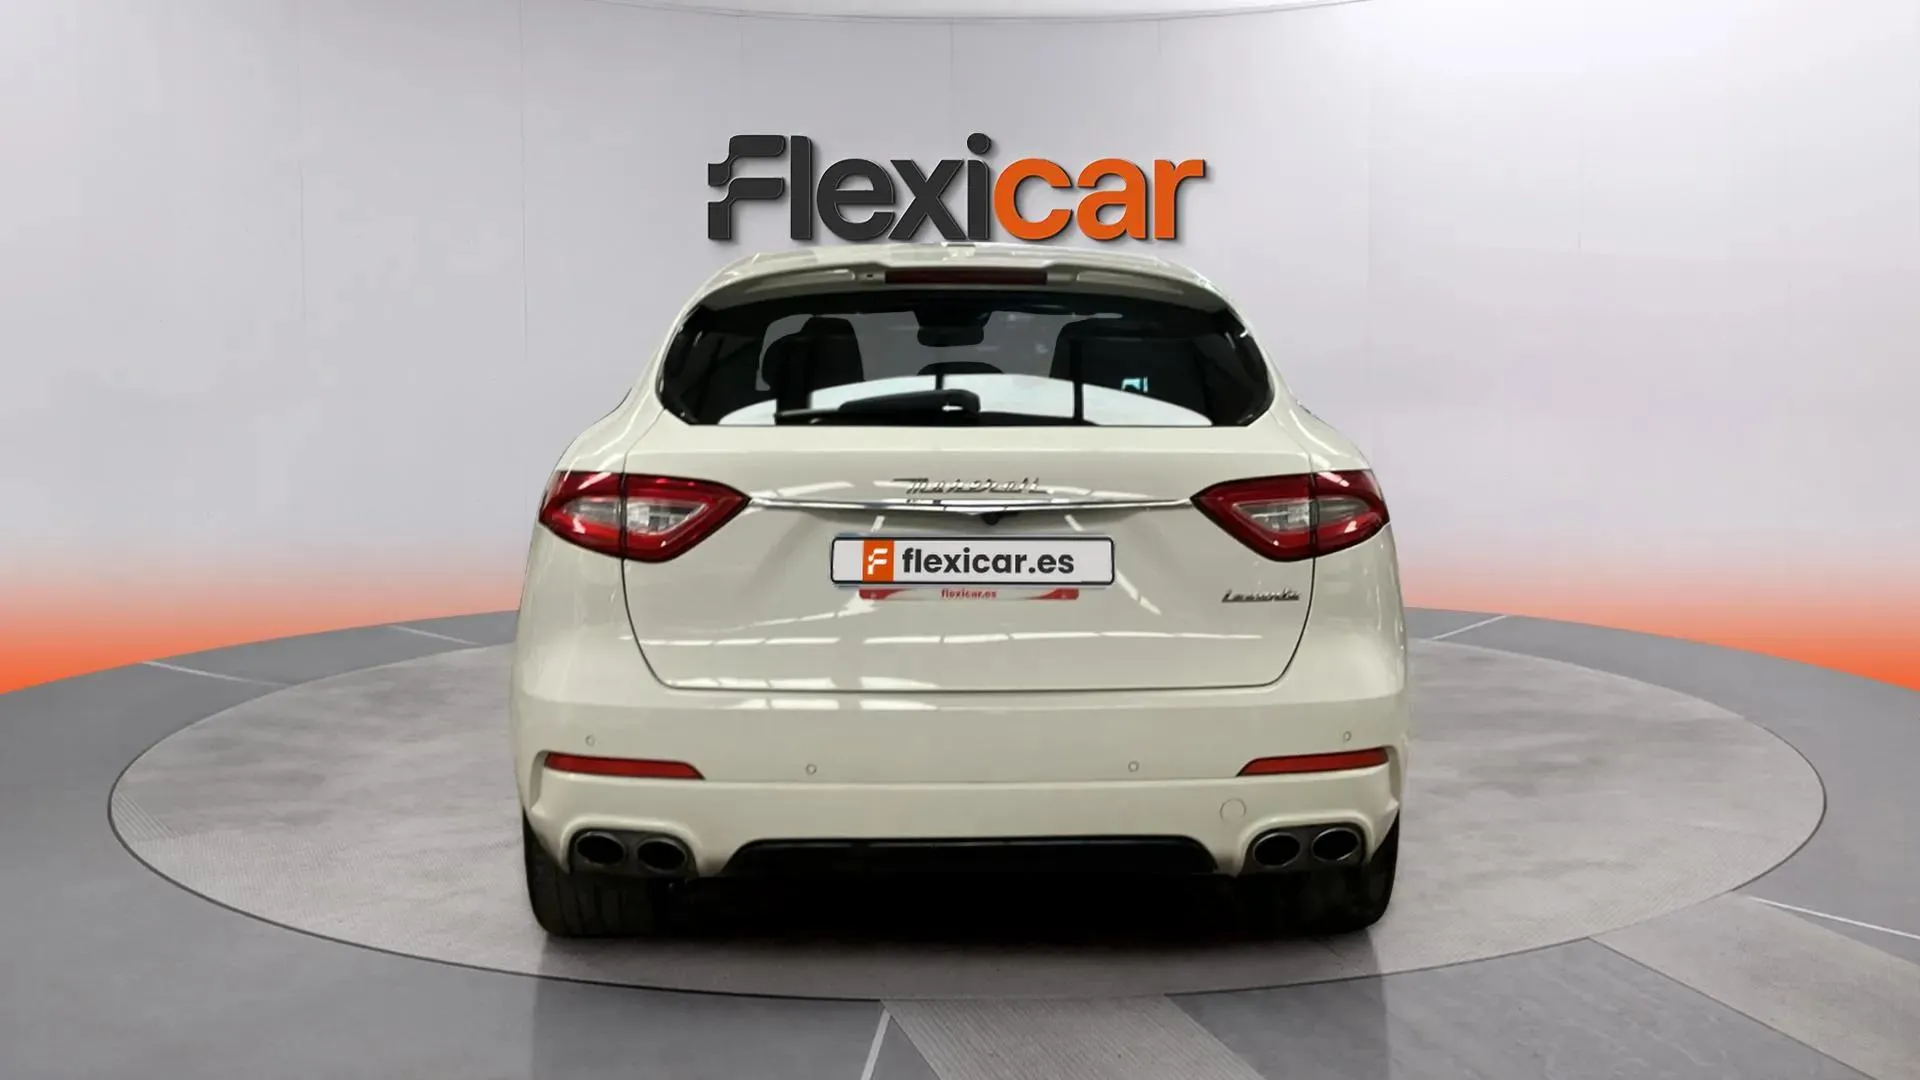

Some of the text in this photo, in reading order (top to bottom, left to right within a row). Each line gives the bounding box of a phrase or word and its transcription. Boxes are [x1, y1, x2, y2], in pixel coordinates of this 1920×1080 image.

[708, 132, 1206, 240] Flexicar
[902, 547, 1074, 574] flexicar.es
[941, 588, 997, 598] flexicar.es
